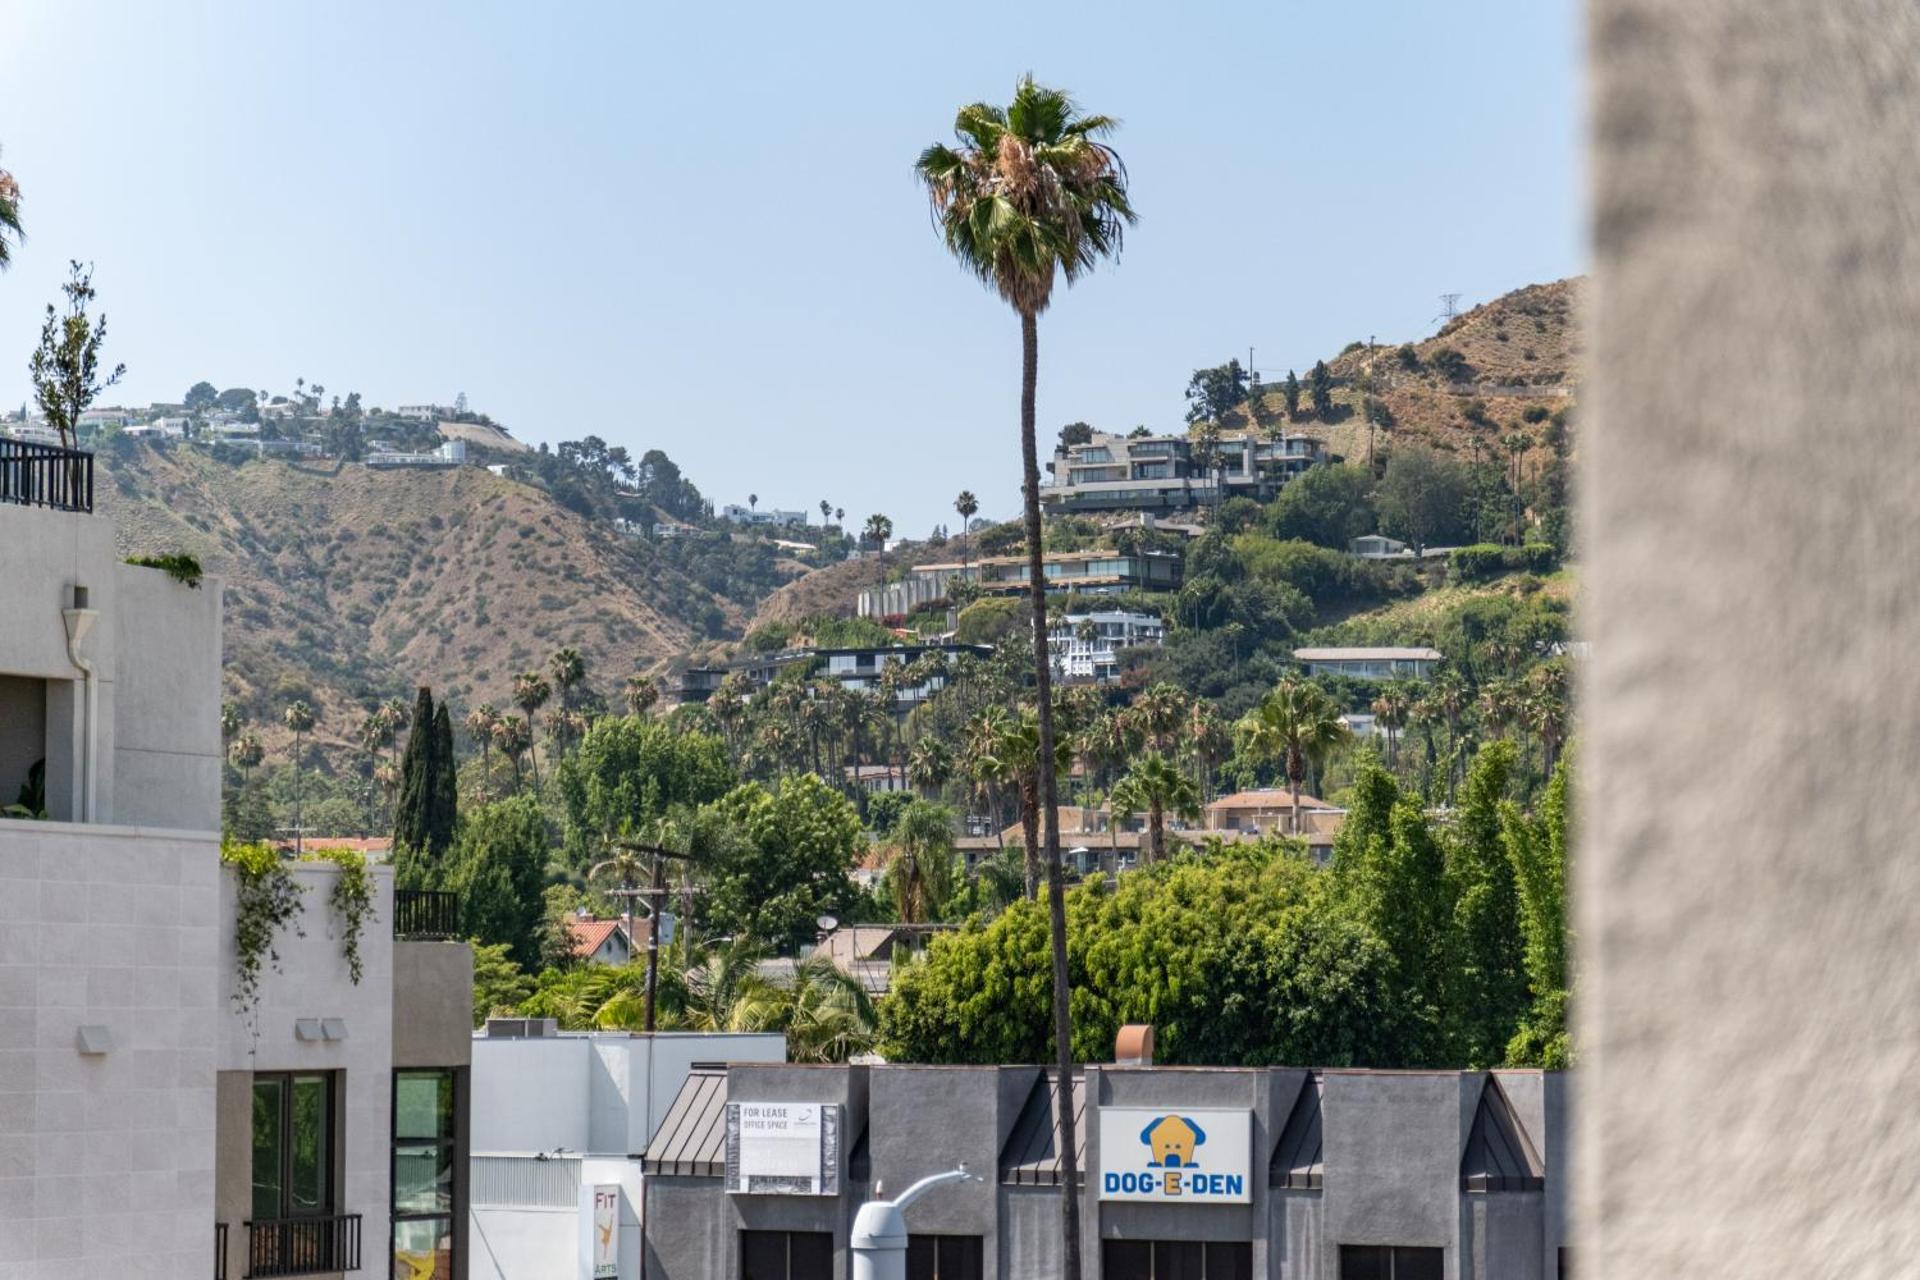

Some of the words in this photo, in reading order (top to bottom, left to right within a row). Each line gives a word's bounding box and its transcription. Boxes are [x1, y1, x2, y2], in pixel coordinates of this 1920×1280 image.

[743, 1107, 760, 1118] FOR
[762, 1108, 787, 1118] LEASE
[743, 1120, 765, 1129] OFFICE
[767, 1120, 787, 1130] SPACE
[1105, 1172, 1243, 1195] DOG-E-DEN
[595, 1192, 616, 1209] FIT
